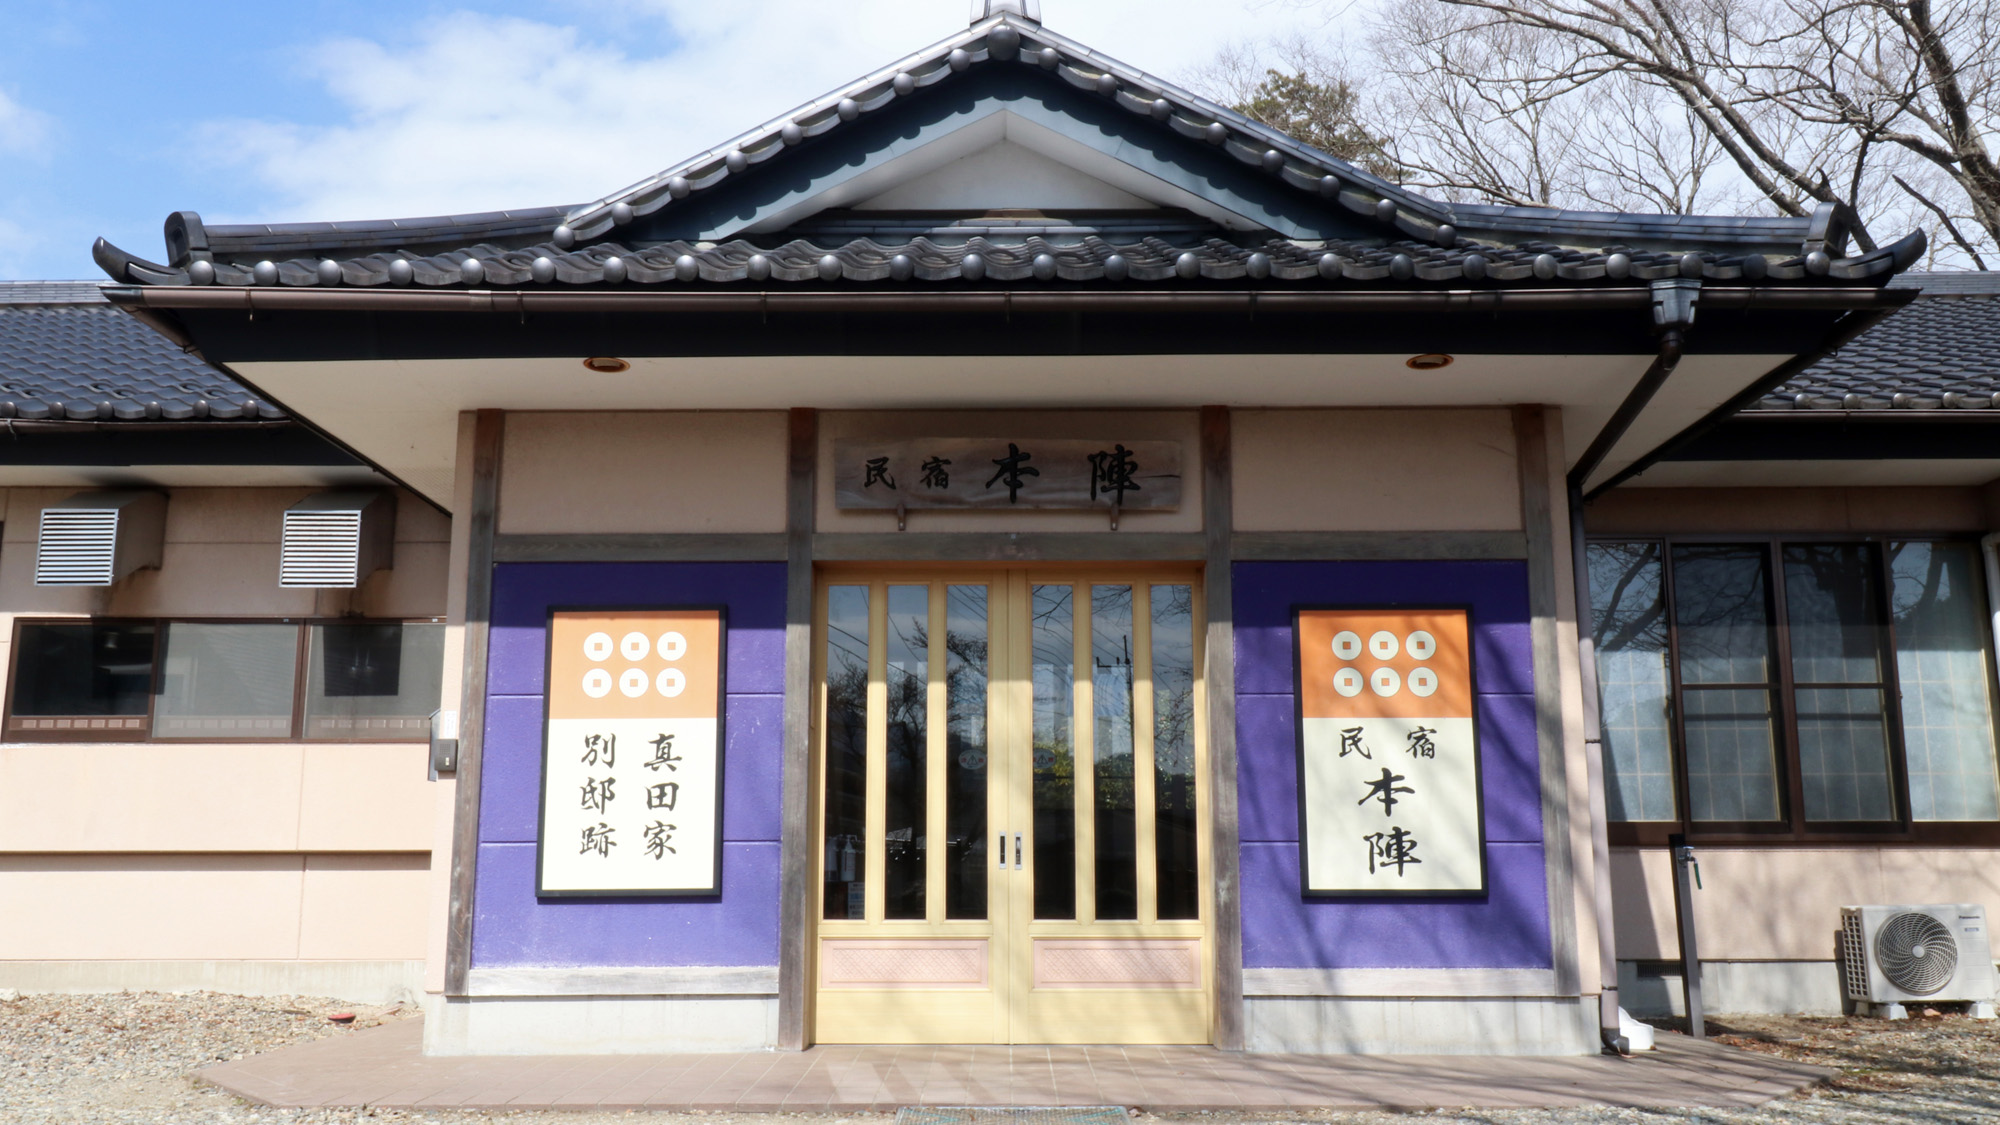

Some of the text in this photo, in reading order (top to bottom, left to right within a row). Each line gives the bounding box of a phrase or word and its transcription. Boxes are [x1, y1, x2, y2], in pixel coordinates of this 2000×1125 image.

[863, 443, 1141, 505] 民宿 本陣
[579, 733, 617, 858] 別邸跡
[643, 733, 683, 860] 真田家
[1339, 726, 1437, 759] 民宿
[1358, 767, 1422, 877] 本陣
